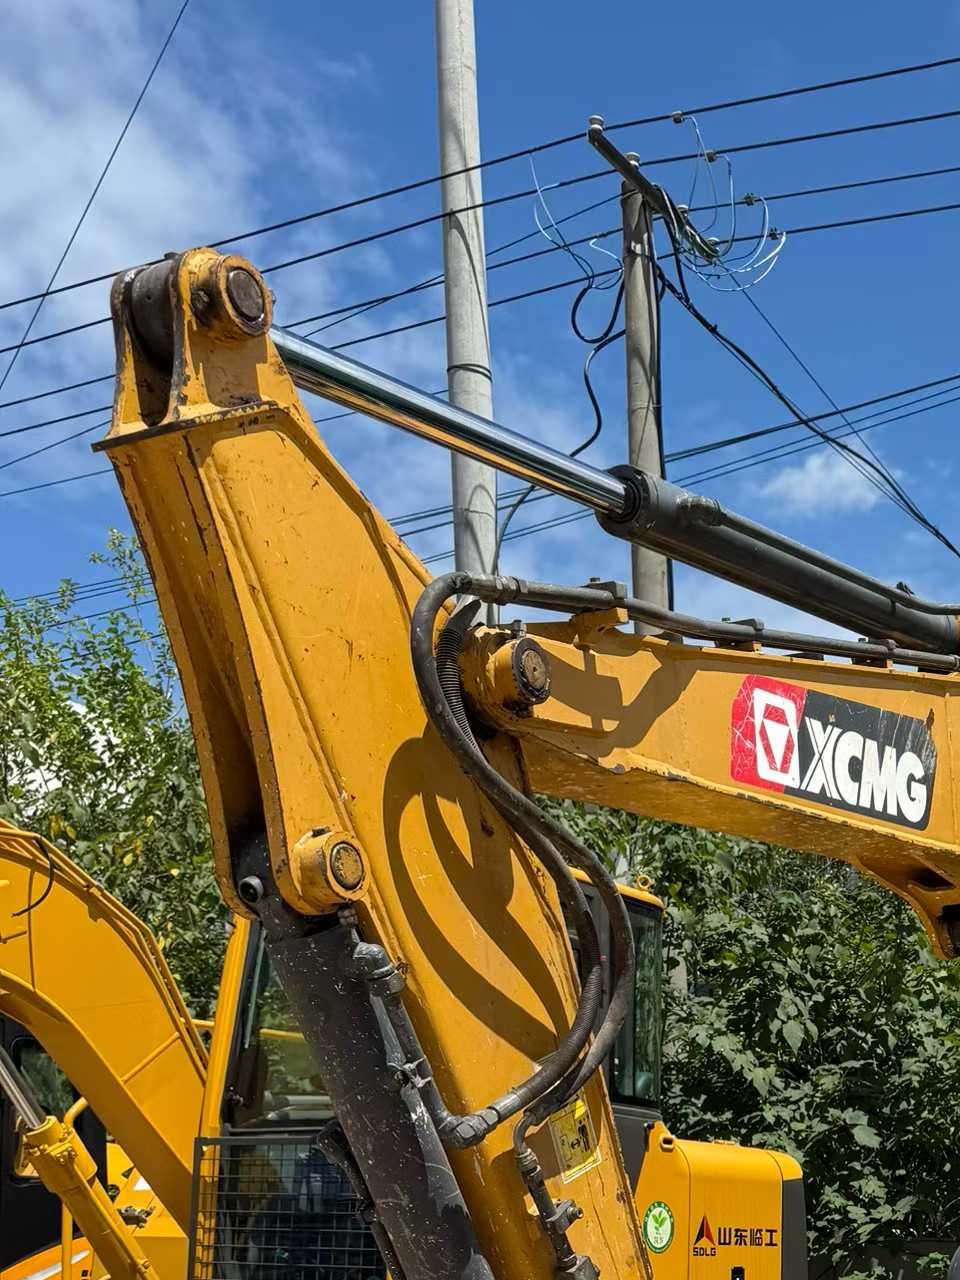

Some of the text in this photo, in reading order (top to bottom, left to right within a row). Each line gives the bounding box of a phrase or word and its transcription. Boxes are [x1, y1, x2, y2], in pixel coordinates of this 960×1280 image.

[800, 716, 928, 823] XCMG
[718, 1227, 778, 1247] 山东临工
[692, 1247, 716, 1257] SDLG
